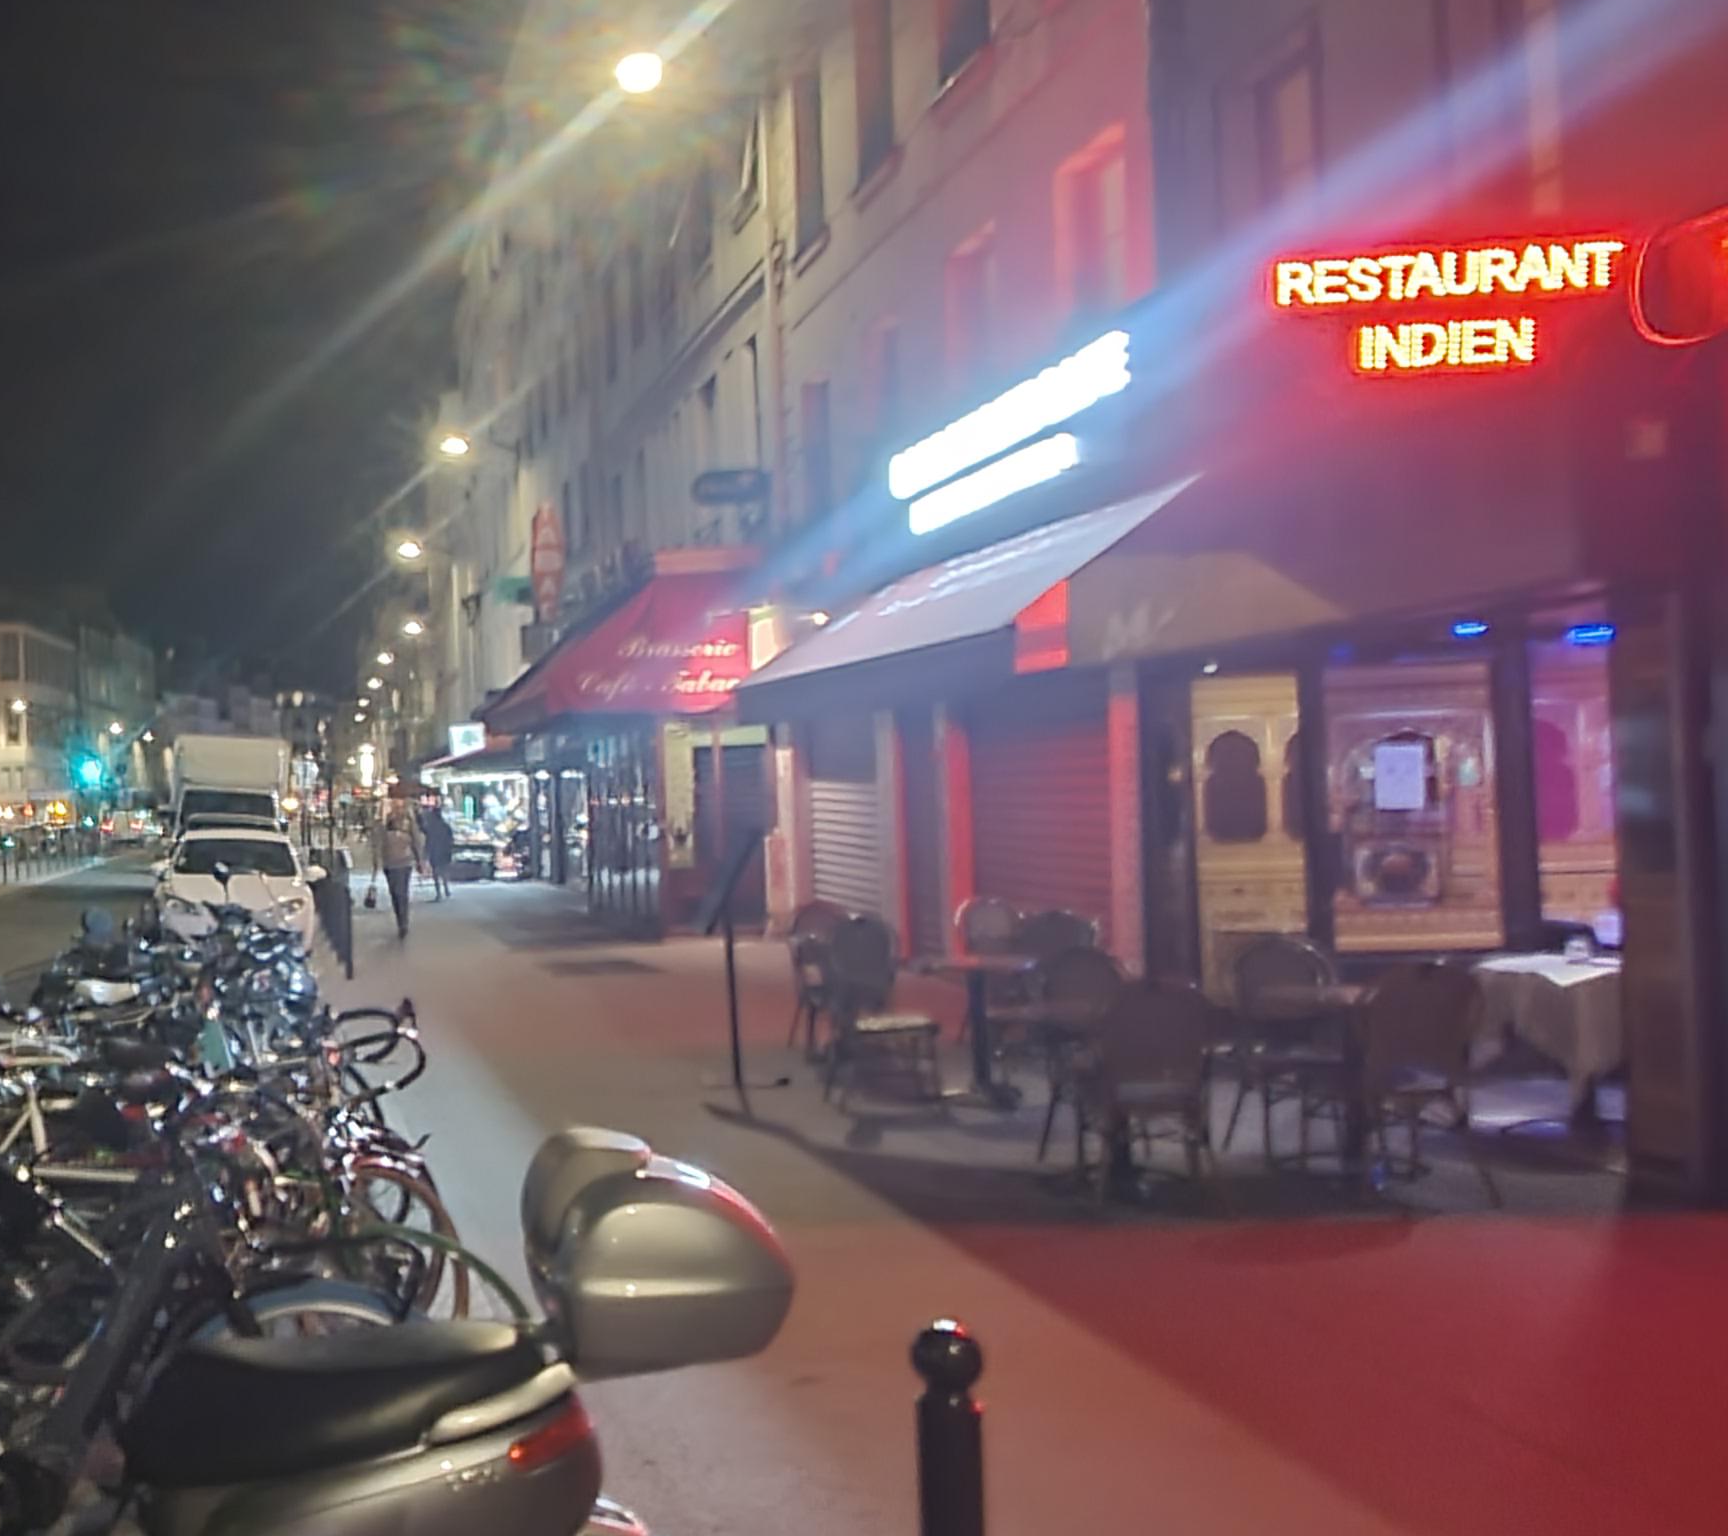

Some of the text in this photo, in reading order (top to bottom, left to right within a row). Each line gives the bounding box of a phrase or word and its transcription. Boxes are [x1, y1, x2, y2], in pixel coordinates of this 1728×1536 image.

[1276, 241, 1625, 306] RESTAURANT
[1358, 317, 1536, 371] INDIEN
[618, 636, 738, 657] Brasserie
